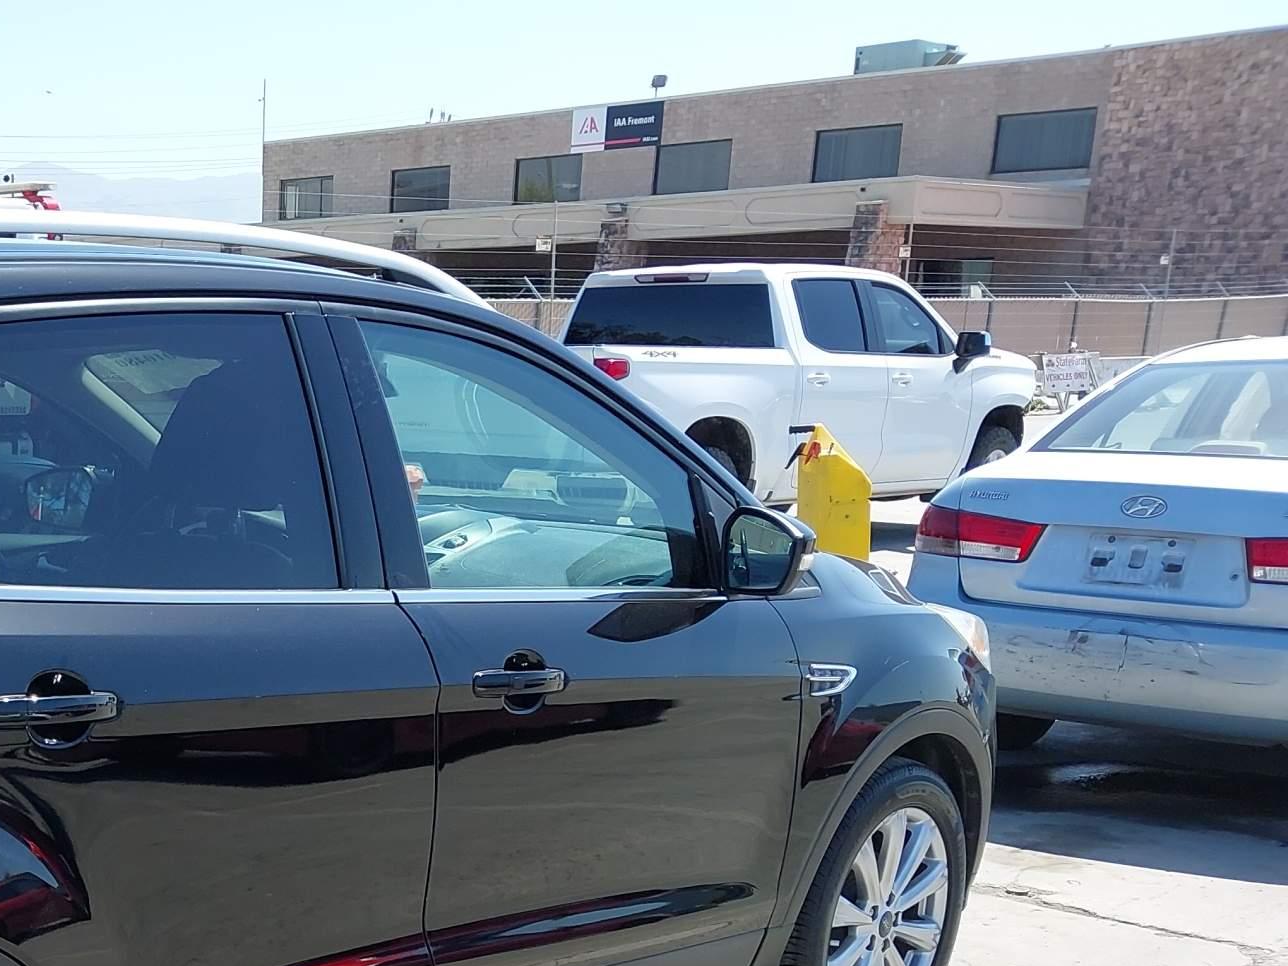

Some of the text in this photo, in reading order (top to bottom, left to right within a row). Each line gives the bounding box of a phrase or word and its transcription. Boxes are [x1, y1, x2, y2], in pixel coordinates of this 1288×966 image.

[614, 114, 655, 127] IAA Fremont
[1045, 371, 1088, 382] VEHICLES ONLY
[969, 489, 1009, 501] HYUNDAI
